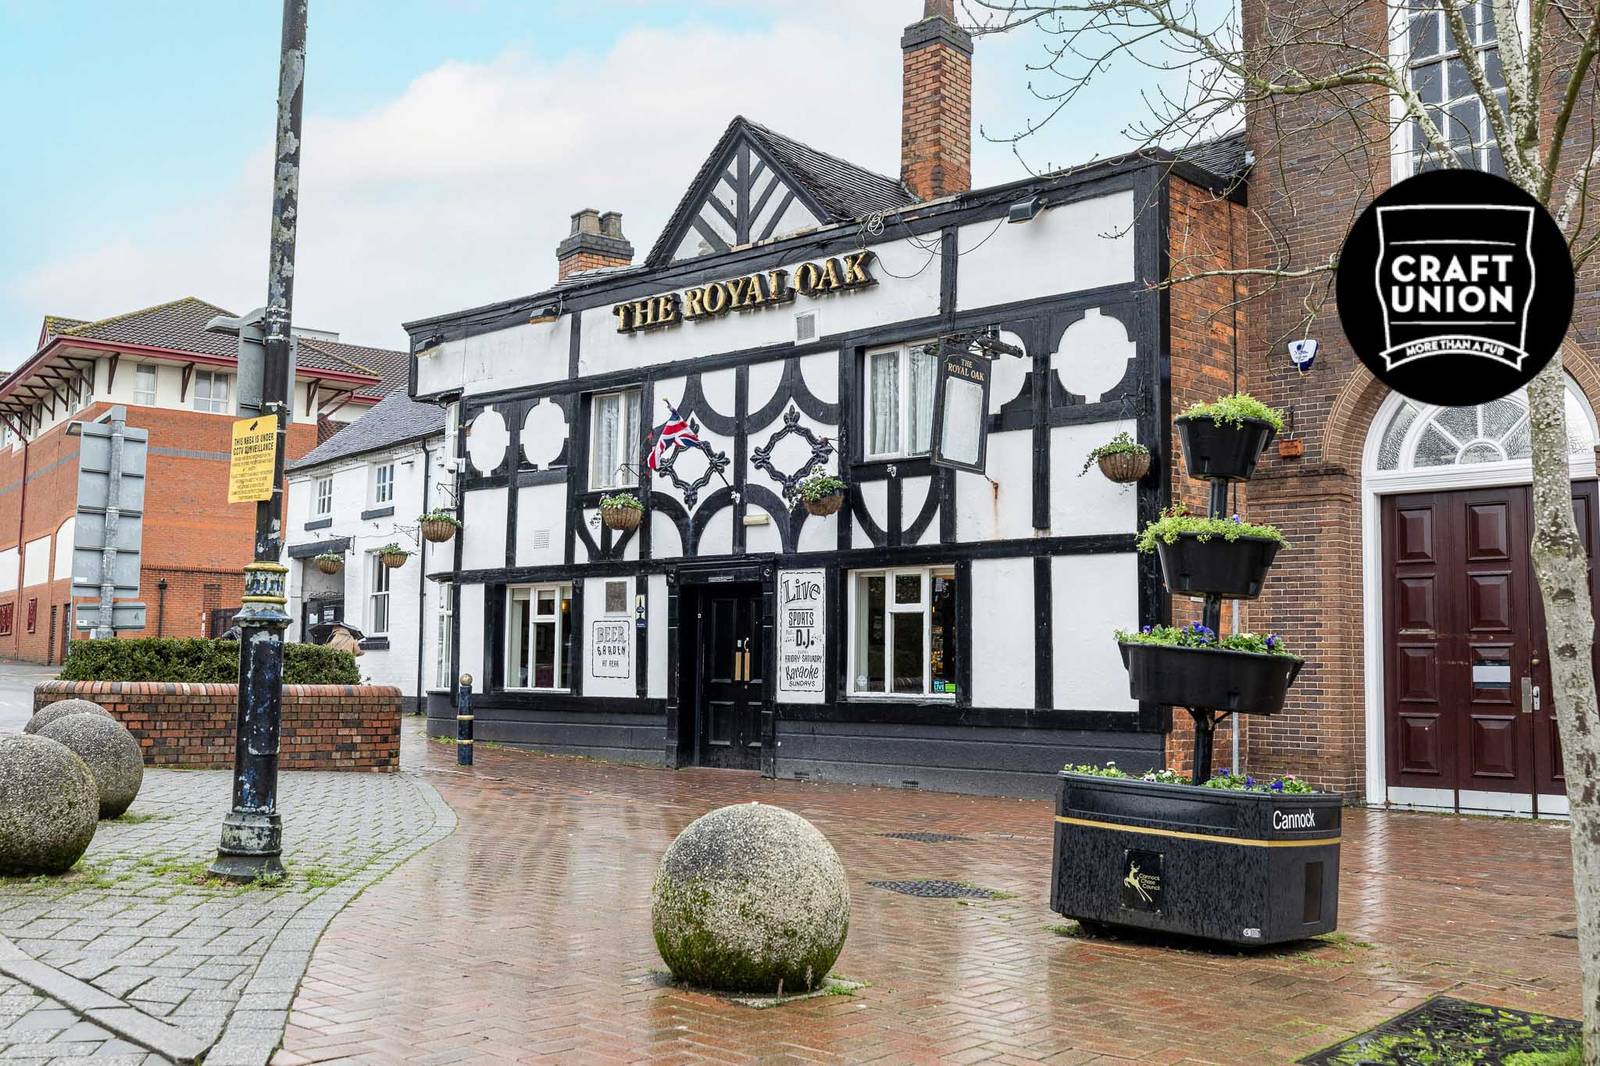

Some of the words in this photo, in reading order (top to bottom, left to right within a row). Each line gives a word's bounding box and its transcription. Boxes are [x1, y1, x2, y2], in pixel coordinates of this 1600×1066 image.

[613, 292, 683, 334] THE
[683, 269, 797, 322] ROYAL
[794, 250, 880, 298] OAK
[961, 358, 973, 369] THE
[947, 362, 970, 377] ROYAL
[970, 370, 985, 382] OAK
[234, 438, 243, 446] THIS
[255, 434, 259, 443] IS
[260, 432, 274, 443] UNDER
[245, 442, 274, 455] SURVEILLANCE
[783, 578, 821, 604] Live
[789, 611, 814, 626] SPORTS
[596, 626, 627, 645] BEER
[796, 629, 815, 649] D.J.
[597, 645, 626, 656] GARDEN
[789, 680, 816, 688] SUNDAYS
[1273, 808, 1316, 830] Cannock
[1139, 873, 1160, 881] Cannock
